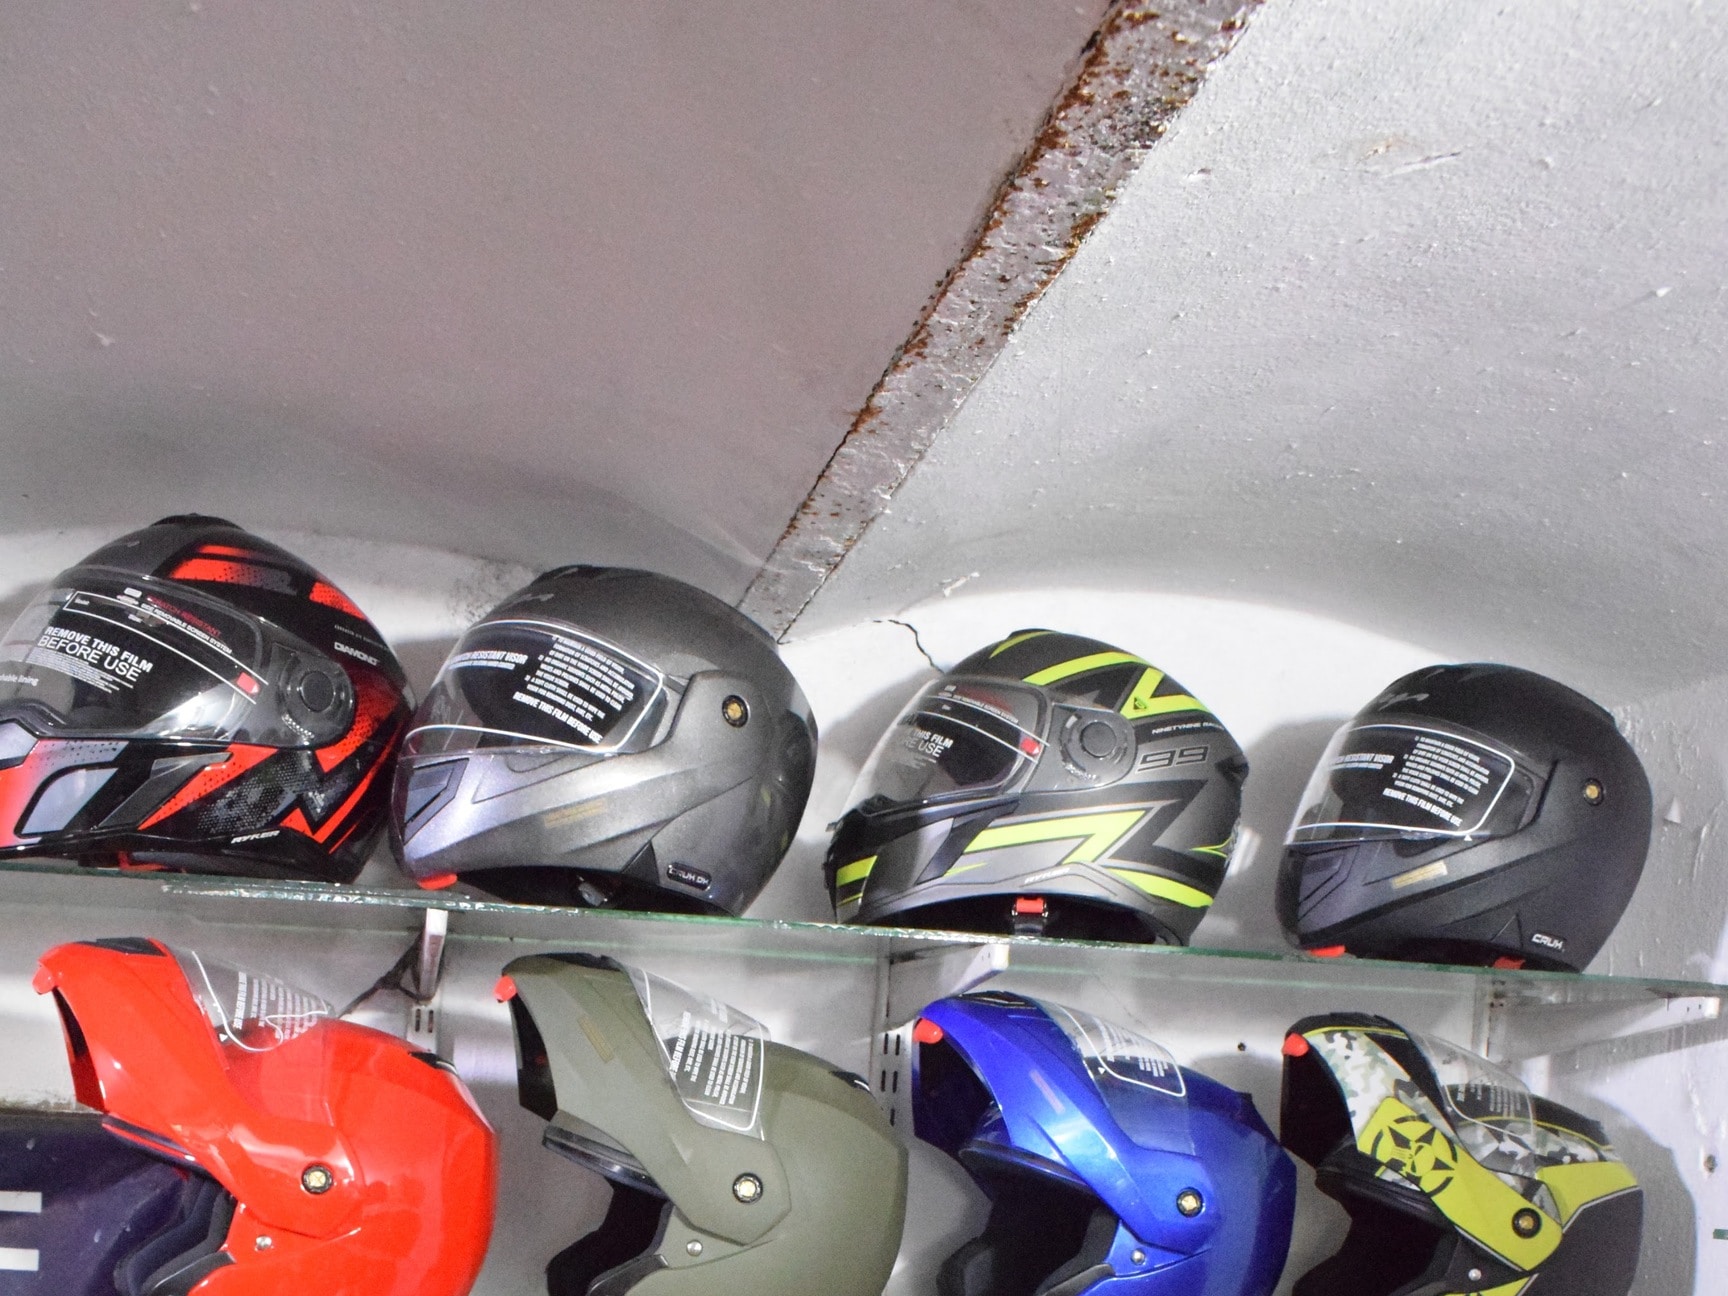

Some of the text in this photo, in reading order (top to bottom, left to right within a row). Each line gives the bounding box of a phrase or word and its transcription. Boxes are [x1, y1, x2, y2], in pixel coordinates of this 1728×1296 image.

[38, 636, 103, 664] BEFORE
[103, 655, 142, 682] USE
[44, 626, 91, 645] REMOVE
[92, 638, 120, 657] THIS
[121, 651, 153, 673] FILM
[918, 740, 944, 758] USE
[930, 733, 954, 748] FILM
[1135, 744, 1210, 774] 99
